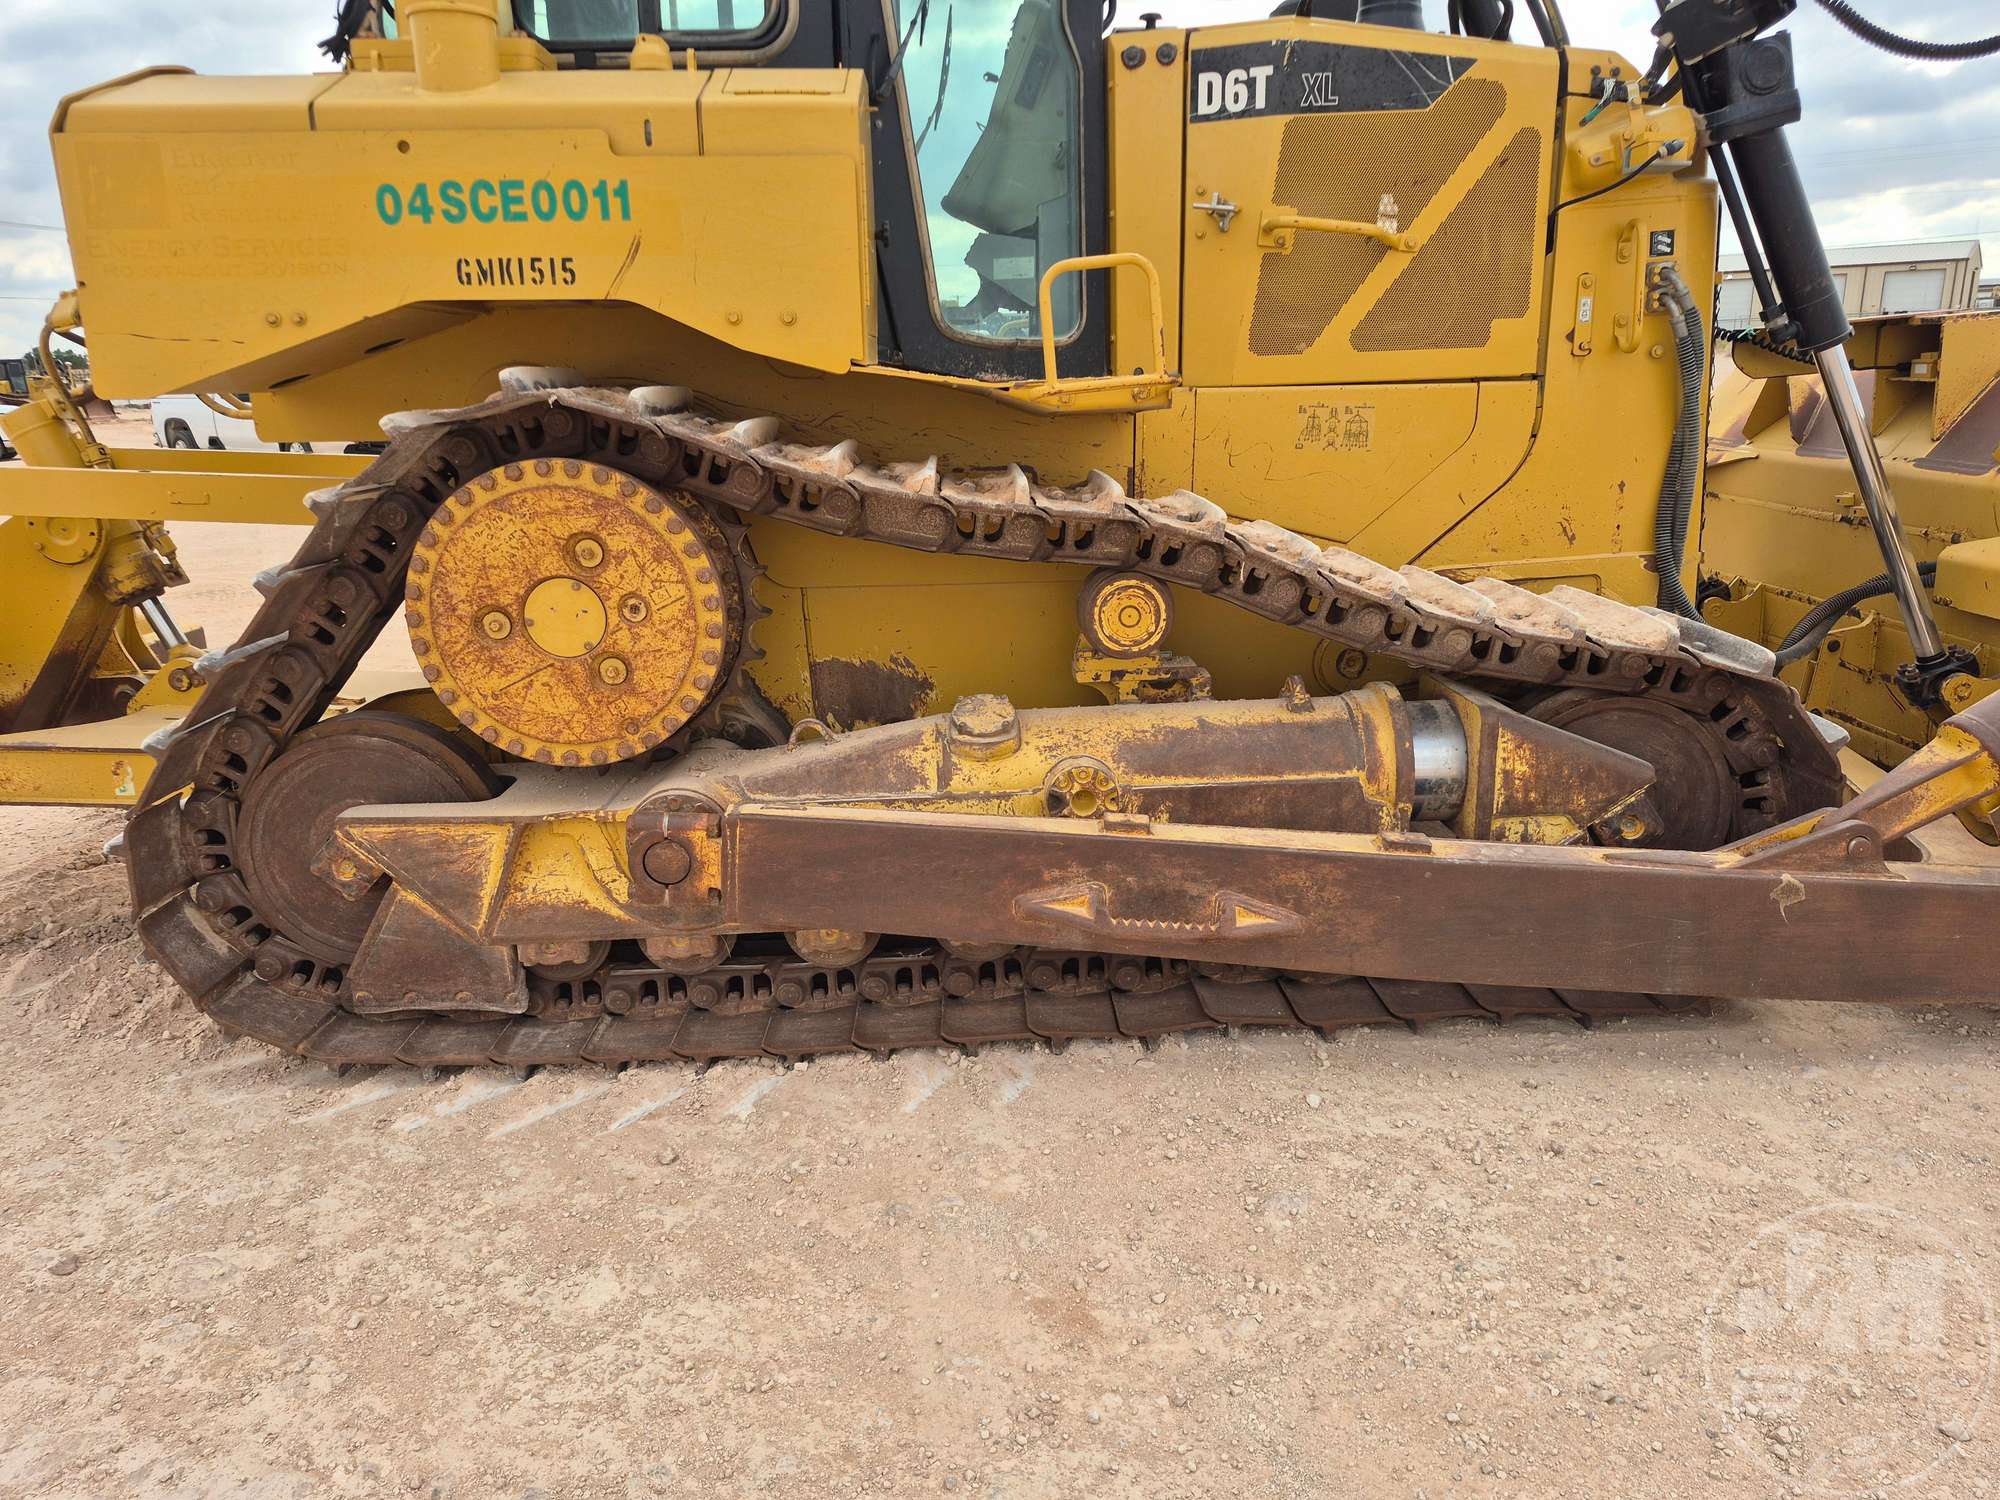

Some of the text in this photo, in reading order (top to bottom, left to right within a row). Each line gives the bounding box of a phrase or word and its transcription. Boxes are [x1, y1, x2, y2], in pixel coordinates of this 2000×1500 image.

[1197, 64, 1340, 116] D6T XL
[375, 178, 633, 226] 04SCE0011
[456, 256, 577, 287] GMK1515
